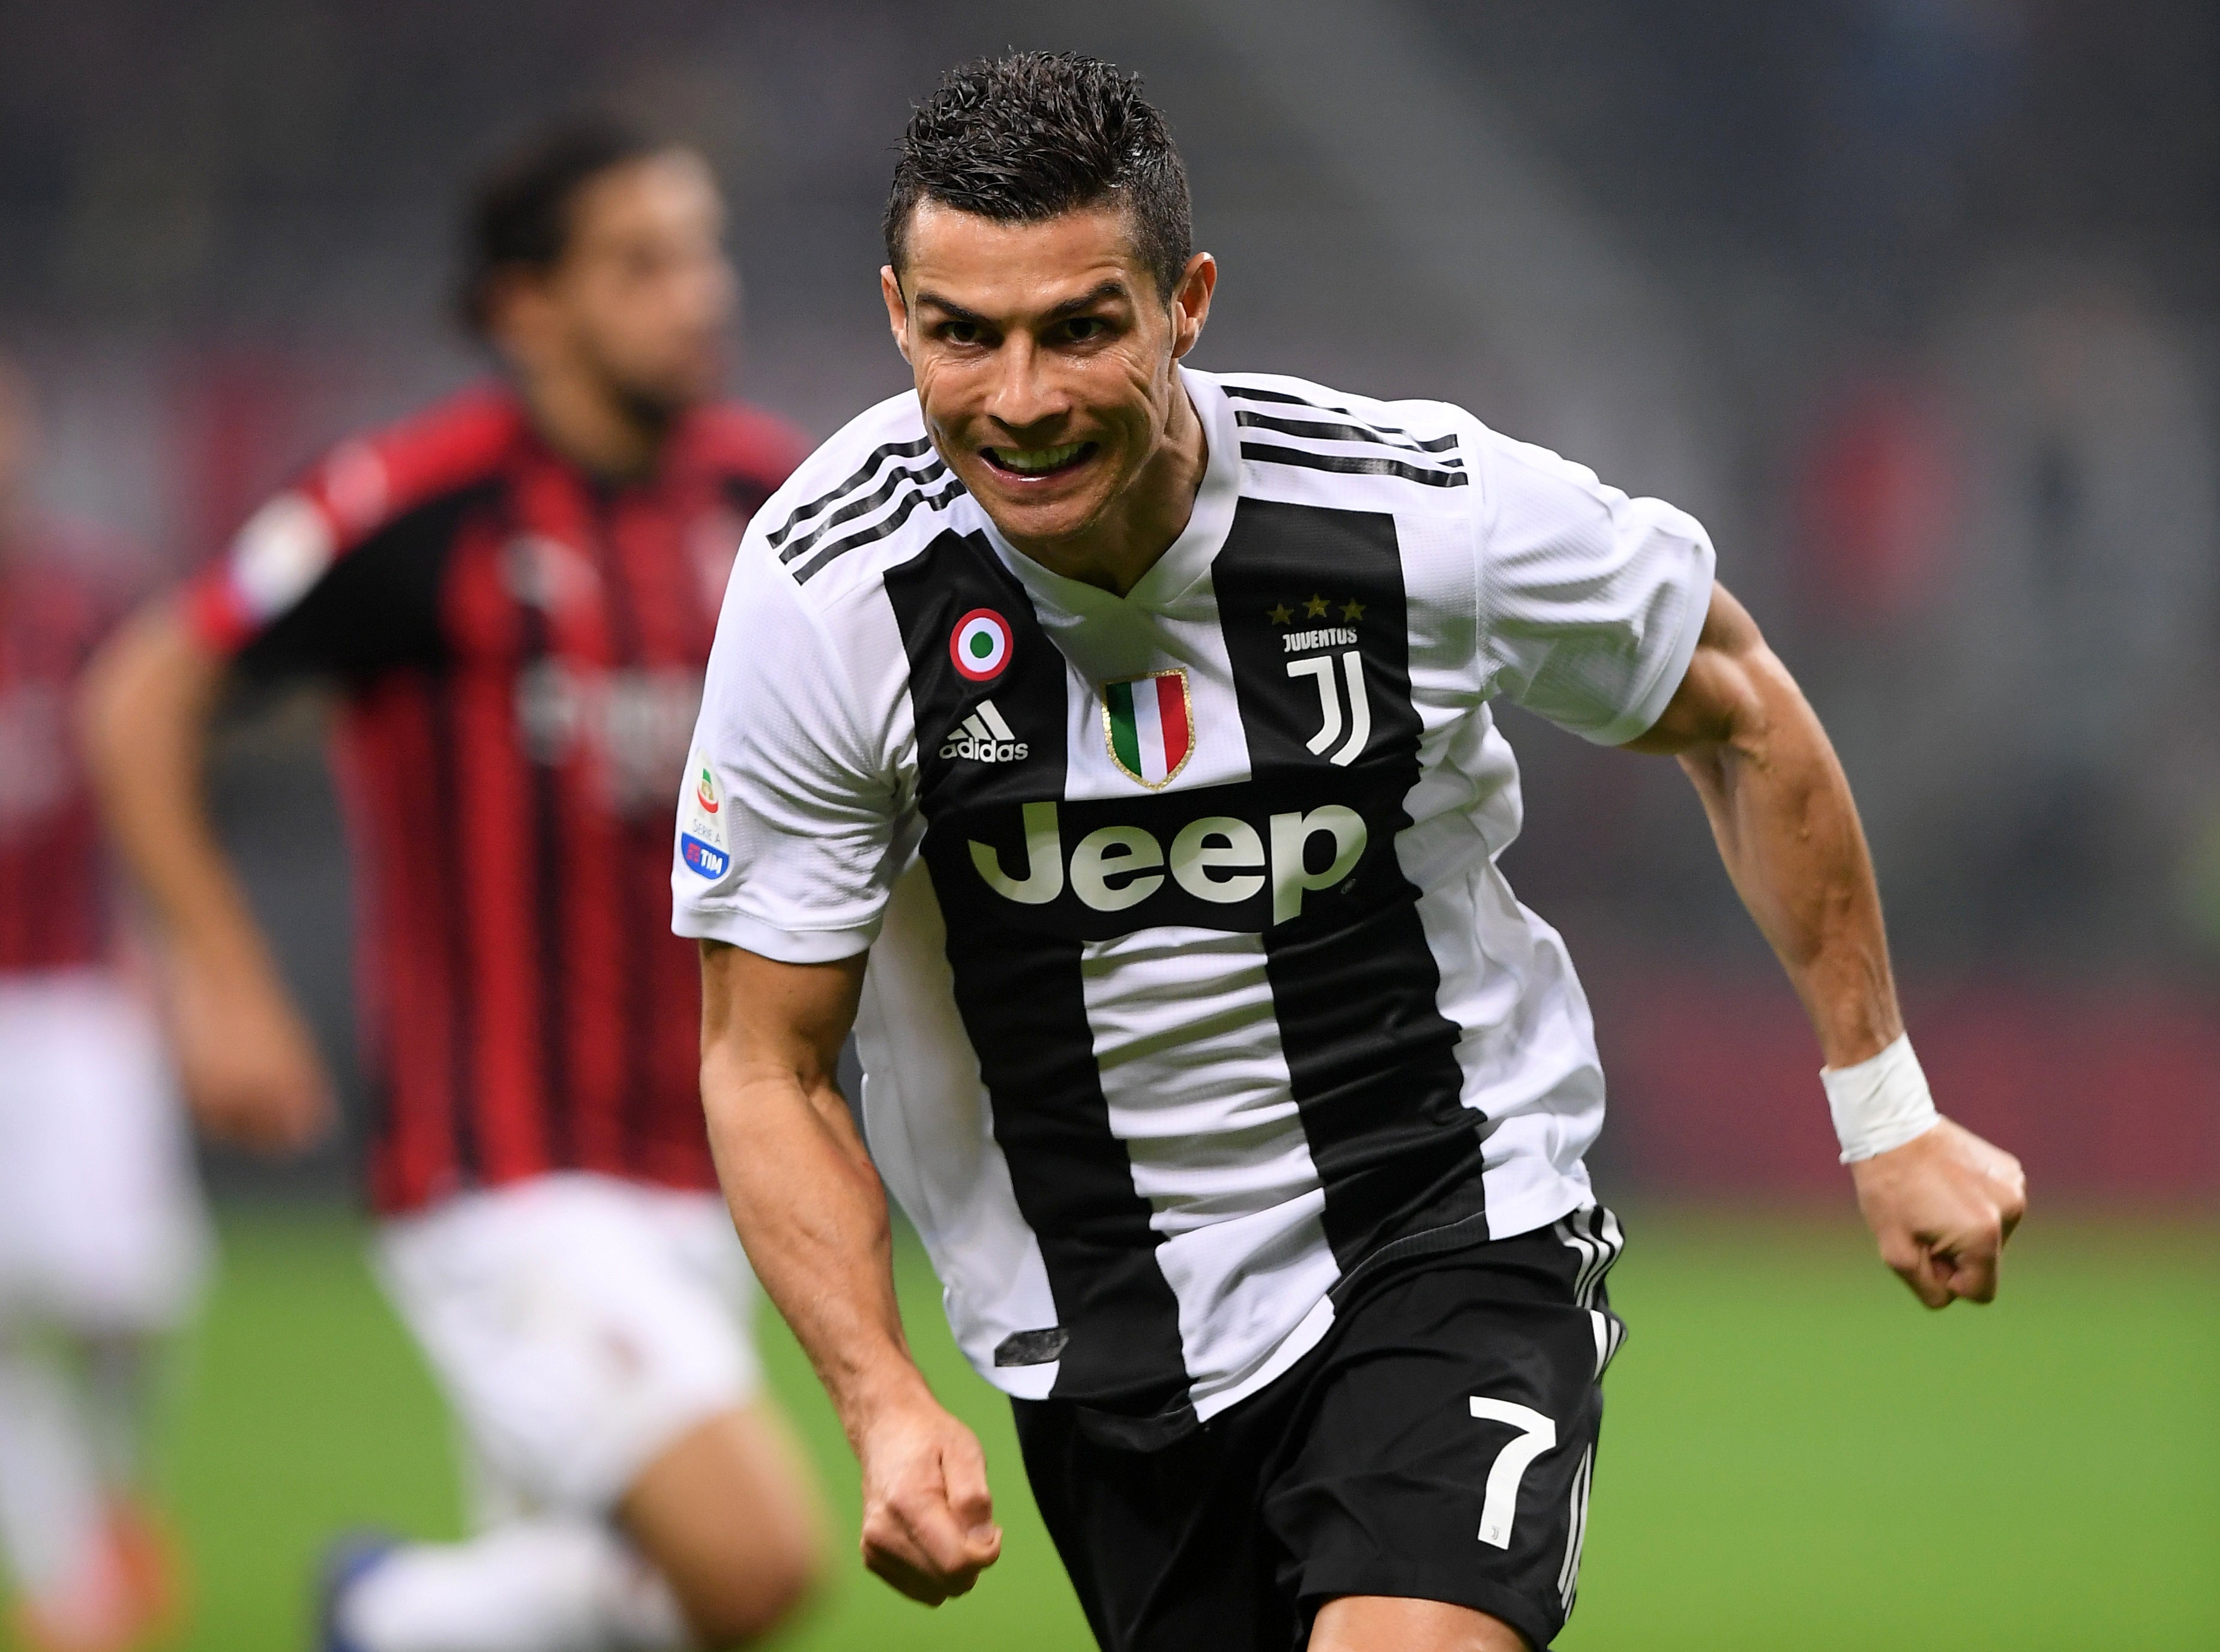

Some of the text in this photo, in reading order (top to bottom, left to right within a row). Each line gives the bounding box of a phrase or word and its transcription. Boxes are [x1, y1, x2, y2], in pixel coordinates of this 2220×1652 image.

[1282, 627, 1358, 653] JUVENTUS
[939, 736, 1029, 763] adidas
[693, 818, 722, 844] SERIE A
[700, 849, 723, 875] TIM
[967, 800, 1368, 926] Jeep
[1469, 1395, 1556, 1550] 7
